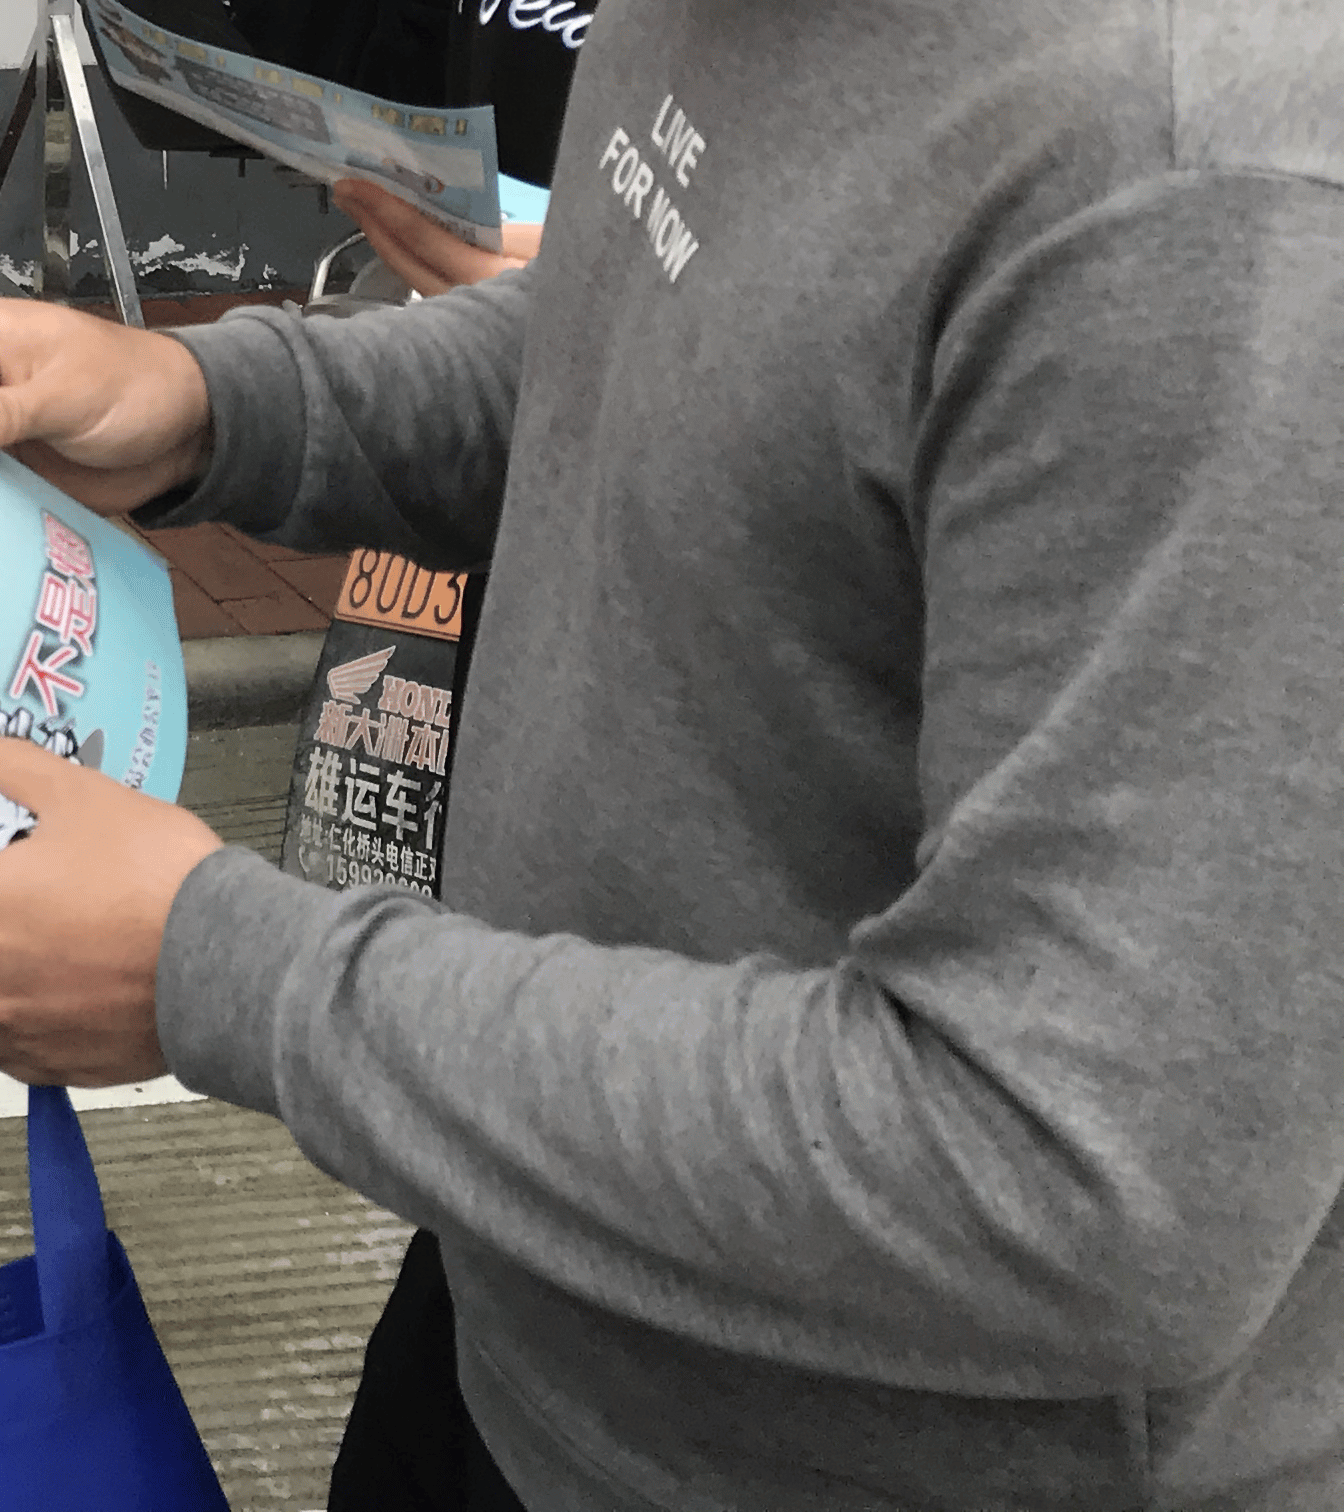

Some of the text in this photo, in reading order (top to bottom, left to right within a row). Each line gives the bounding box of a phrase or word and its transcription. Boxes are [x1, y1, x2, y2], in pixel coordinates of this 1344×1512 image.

[651, 94, 707, 188] LIVE
[598, 126, 700, 285] FOR NOW
